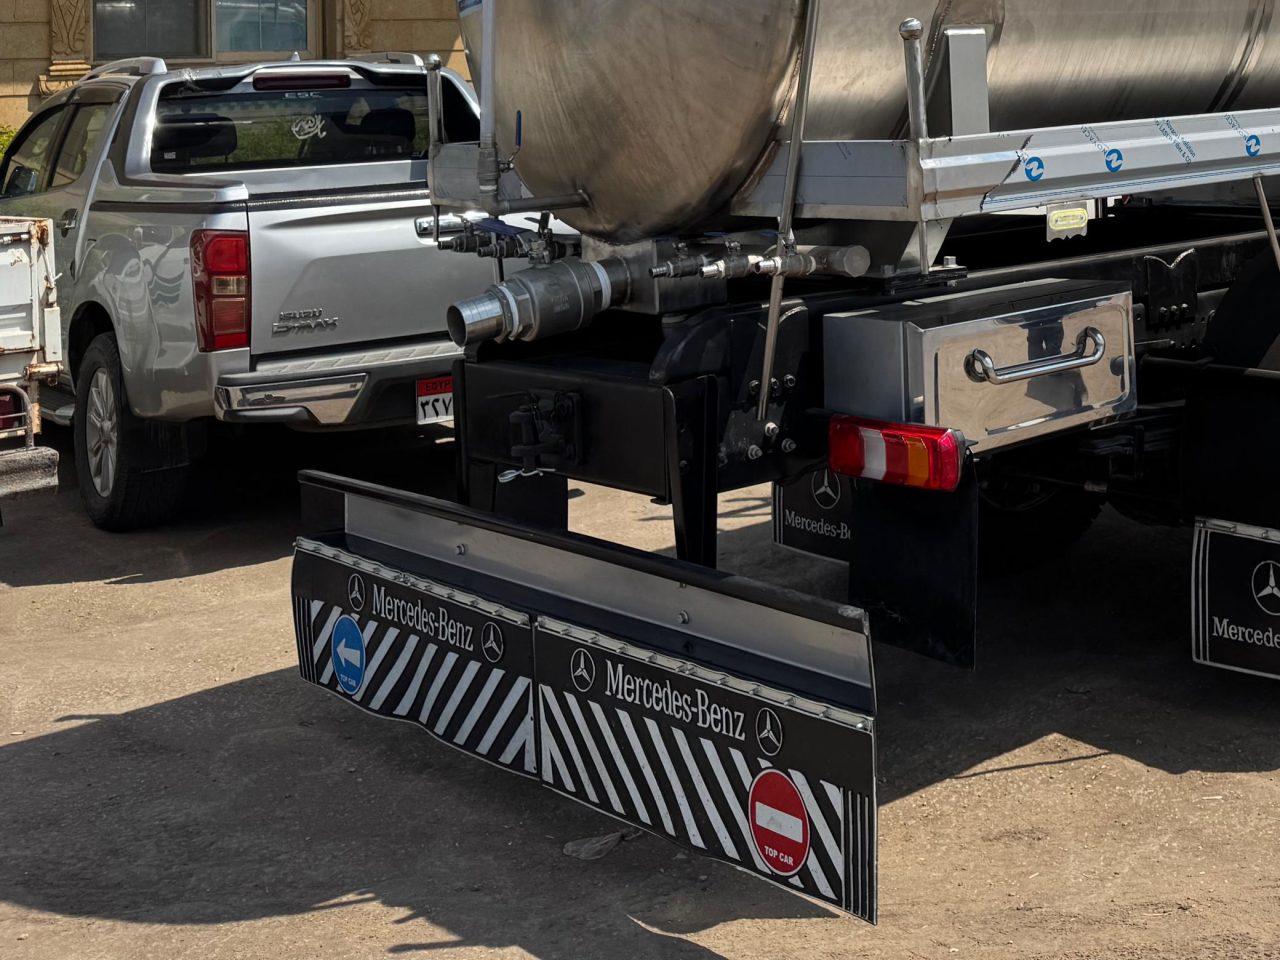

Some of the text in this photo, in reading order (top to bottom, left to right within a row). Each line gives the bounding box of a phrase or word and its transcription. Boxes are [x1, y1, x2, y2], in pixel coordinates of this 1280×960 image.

[279, 308, 323, 321] ISUZU
[425, 379, 452, 392] EGYP
[372, 583, 474, 652] Mercedes-Benz
[605, 659, 746, 741] Mercedes-Benz
[764, 845, 794, 866] TOP CAR
